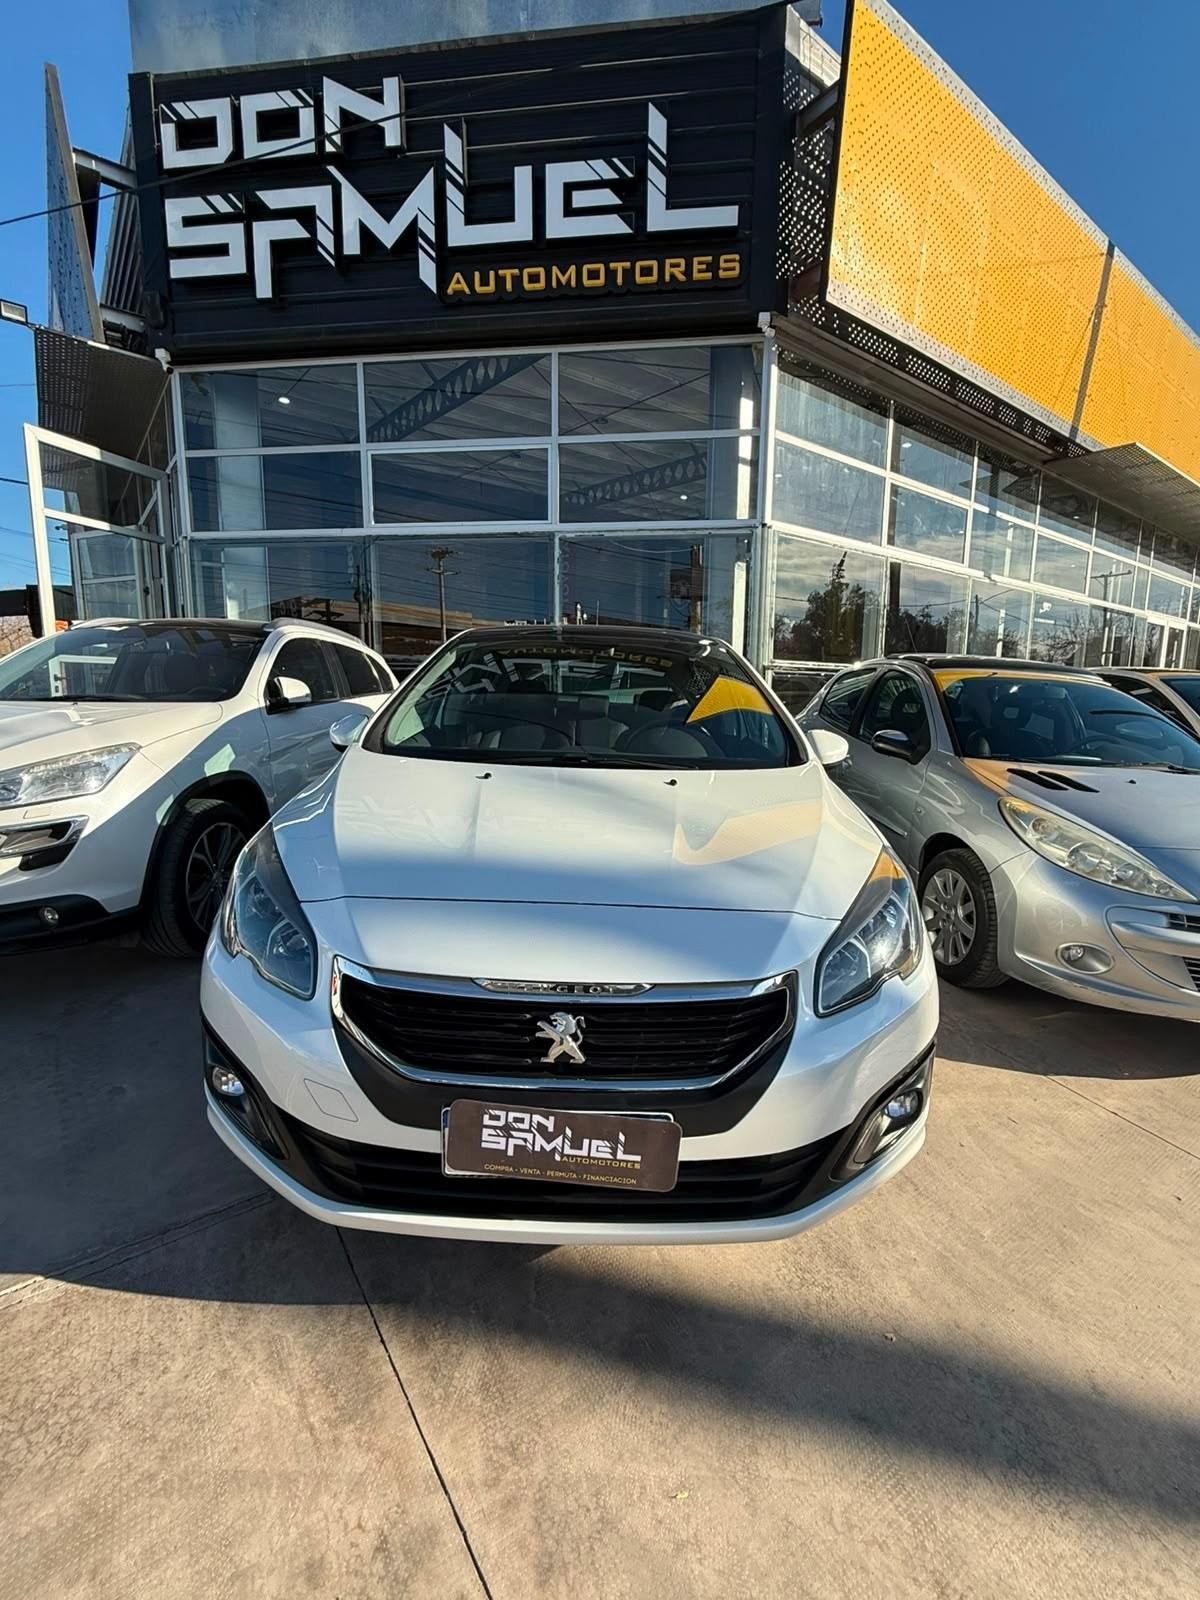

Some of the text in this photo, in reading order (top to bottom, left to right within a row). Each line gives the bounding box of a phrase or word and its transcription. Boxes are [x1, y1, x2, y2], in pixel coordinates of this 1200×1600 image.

[160, 76, 403, 169] DON
[164, 101, 740, 300] SAMUEL
[447, 253, 742, 296] AUTOMOTORES
[483, 1109, 555, 1132] DON
[481, 1126, 642, 1162] SAMUEL
[484, 1163, 513, 1173] COMPRA
[519, 1167, 541, 1175] VENTA
[546, 1170, 577, 1179] PERMUTA
[583, 1174, 637, 1185] FINANCIACION
[561, 1156, 641, 1170] AUTOMOTORES
